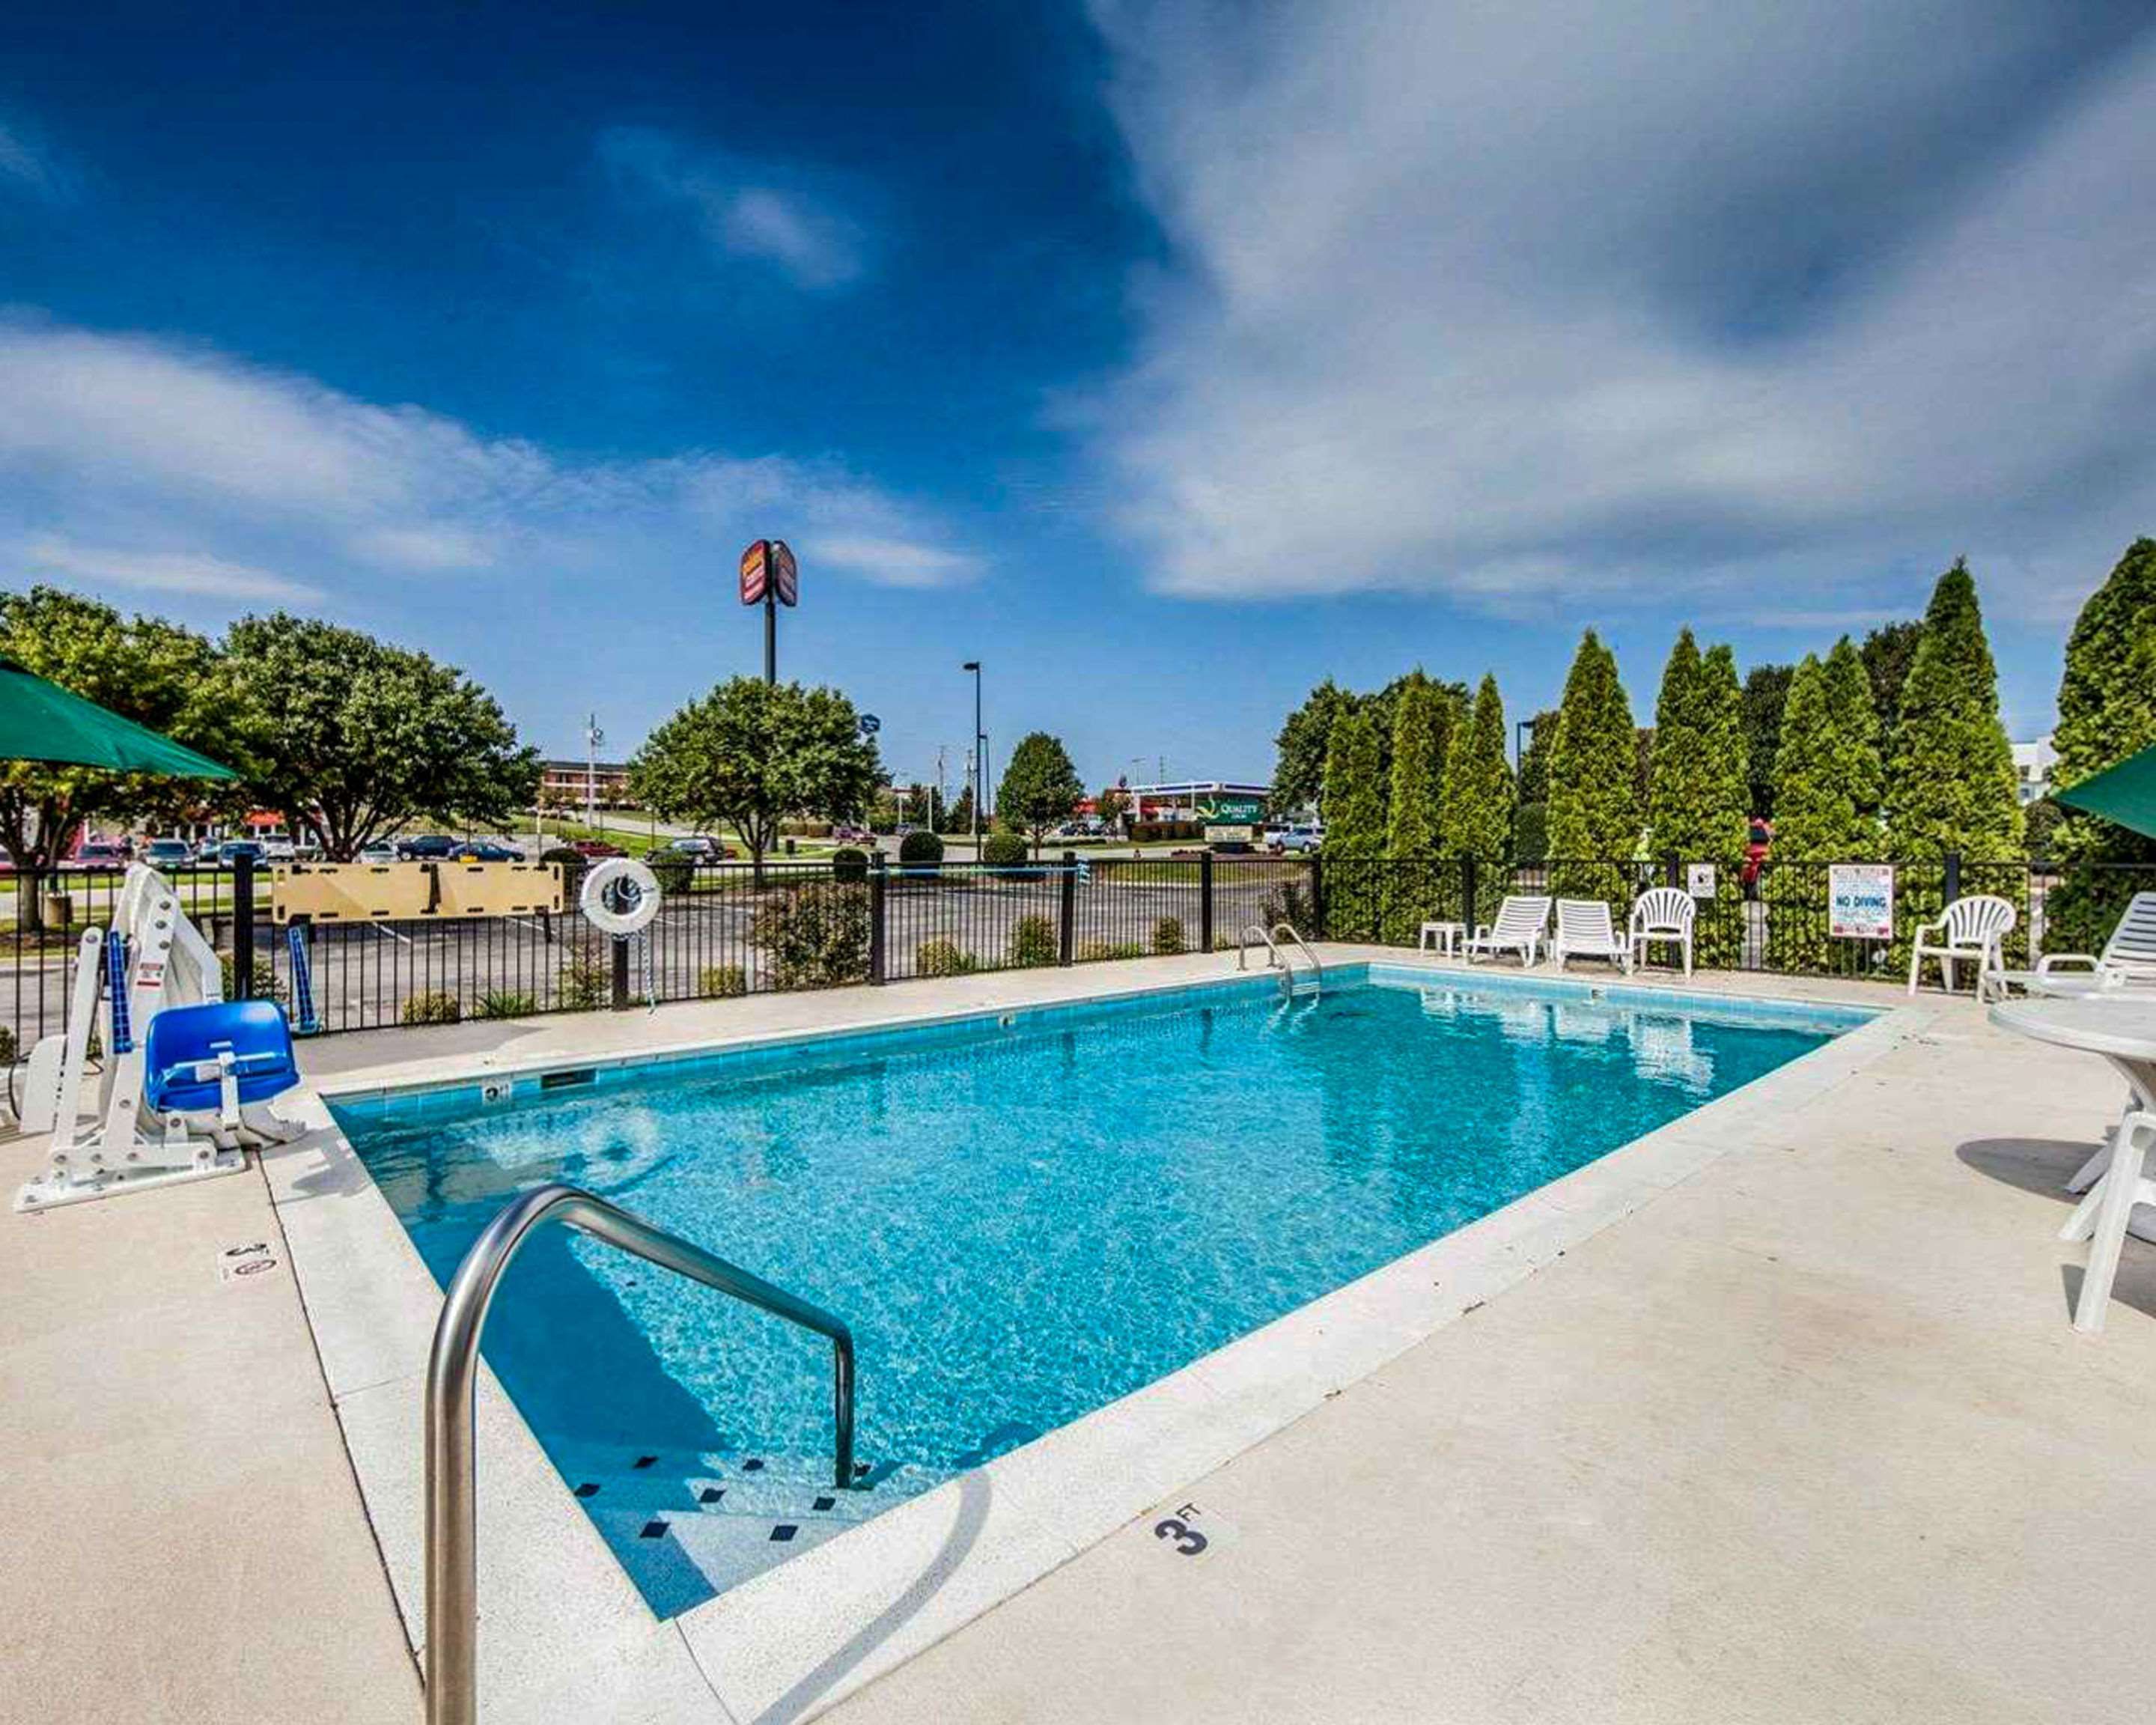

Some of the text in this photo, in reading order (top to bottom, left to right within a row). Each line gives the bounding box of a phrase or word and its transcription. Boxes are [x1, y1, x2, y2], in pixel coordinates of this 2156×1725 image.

[1836, 895, 1886, 907] NO DIVING
[1154, 1503, 1208, 1556] 3 FT
